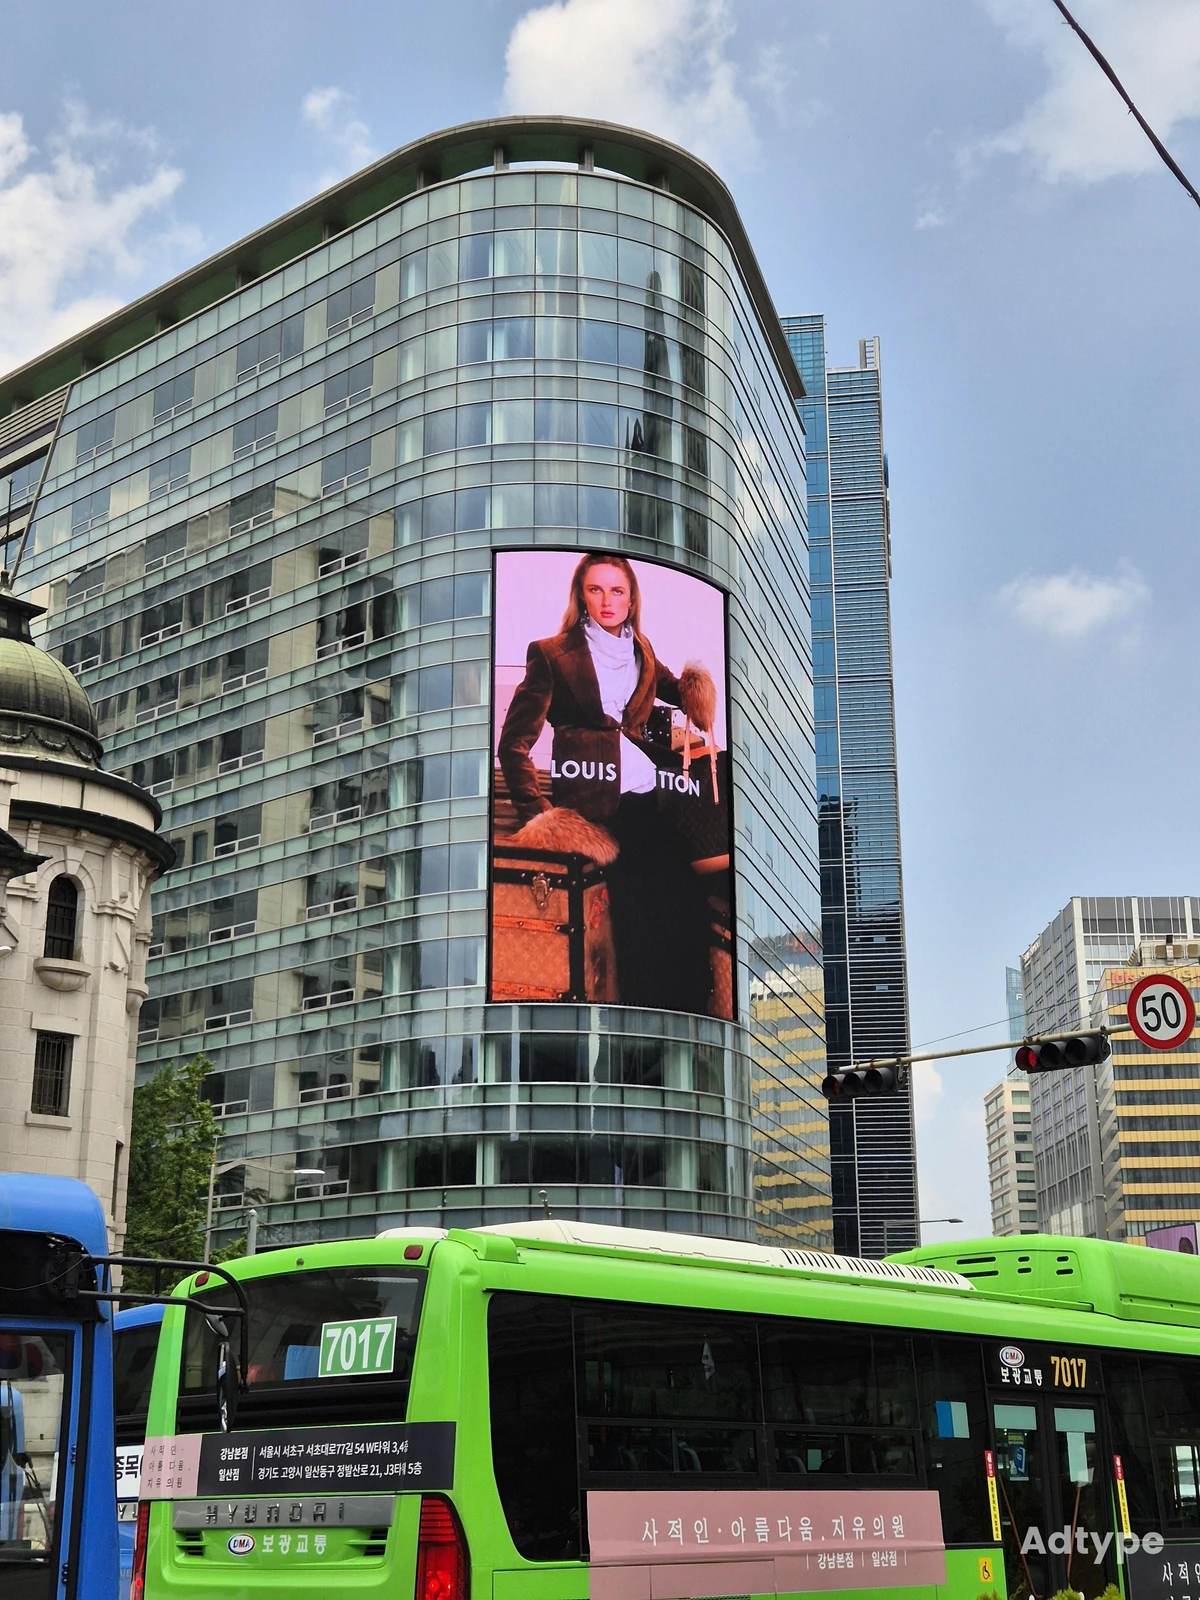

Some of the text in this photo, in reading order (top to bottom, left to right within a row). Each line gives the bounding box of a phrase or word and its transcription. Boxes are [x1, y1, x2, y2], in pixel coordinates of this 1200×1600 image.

[550, 759, 617, 782] LOUIS
[1141, 991, 1182, 1032] 50
[326, 1323, 392, 1371] 7017
[1005, 1351, 1020, 1361] DMA
[1000, 1356, 1087, 1388] 보광교통 7017
[220, 1446, 249, 1460] 강남본점
[259, 1445, 281, 1459] 서울시
[282, 1444, 304, 1458] 서초구
[305, 1442, 354, 1456] 서초대로77길
[354, 1442, 365, 1455] 54
[365, 1440, 391, 1455] W타워
[218, 1467, 240, 1482] 일산점
[257, 1466, 280, 1480] 경기도
[280, 1465, 303, 1479] 고양시
[304, 1465, 335, 1479] 일산동구
[336, 1463, 369, 1478] 정발산로
[407, 1461, 423, 1475] 5층
[205, 1501, 345, 1524] HYUNDAI
[232, 1539, 251, 1549] DMA
[261, 1534, 327, 1555] 보광교통
[817, 1550, 898, 1569] 강남본점 일산점
